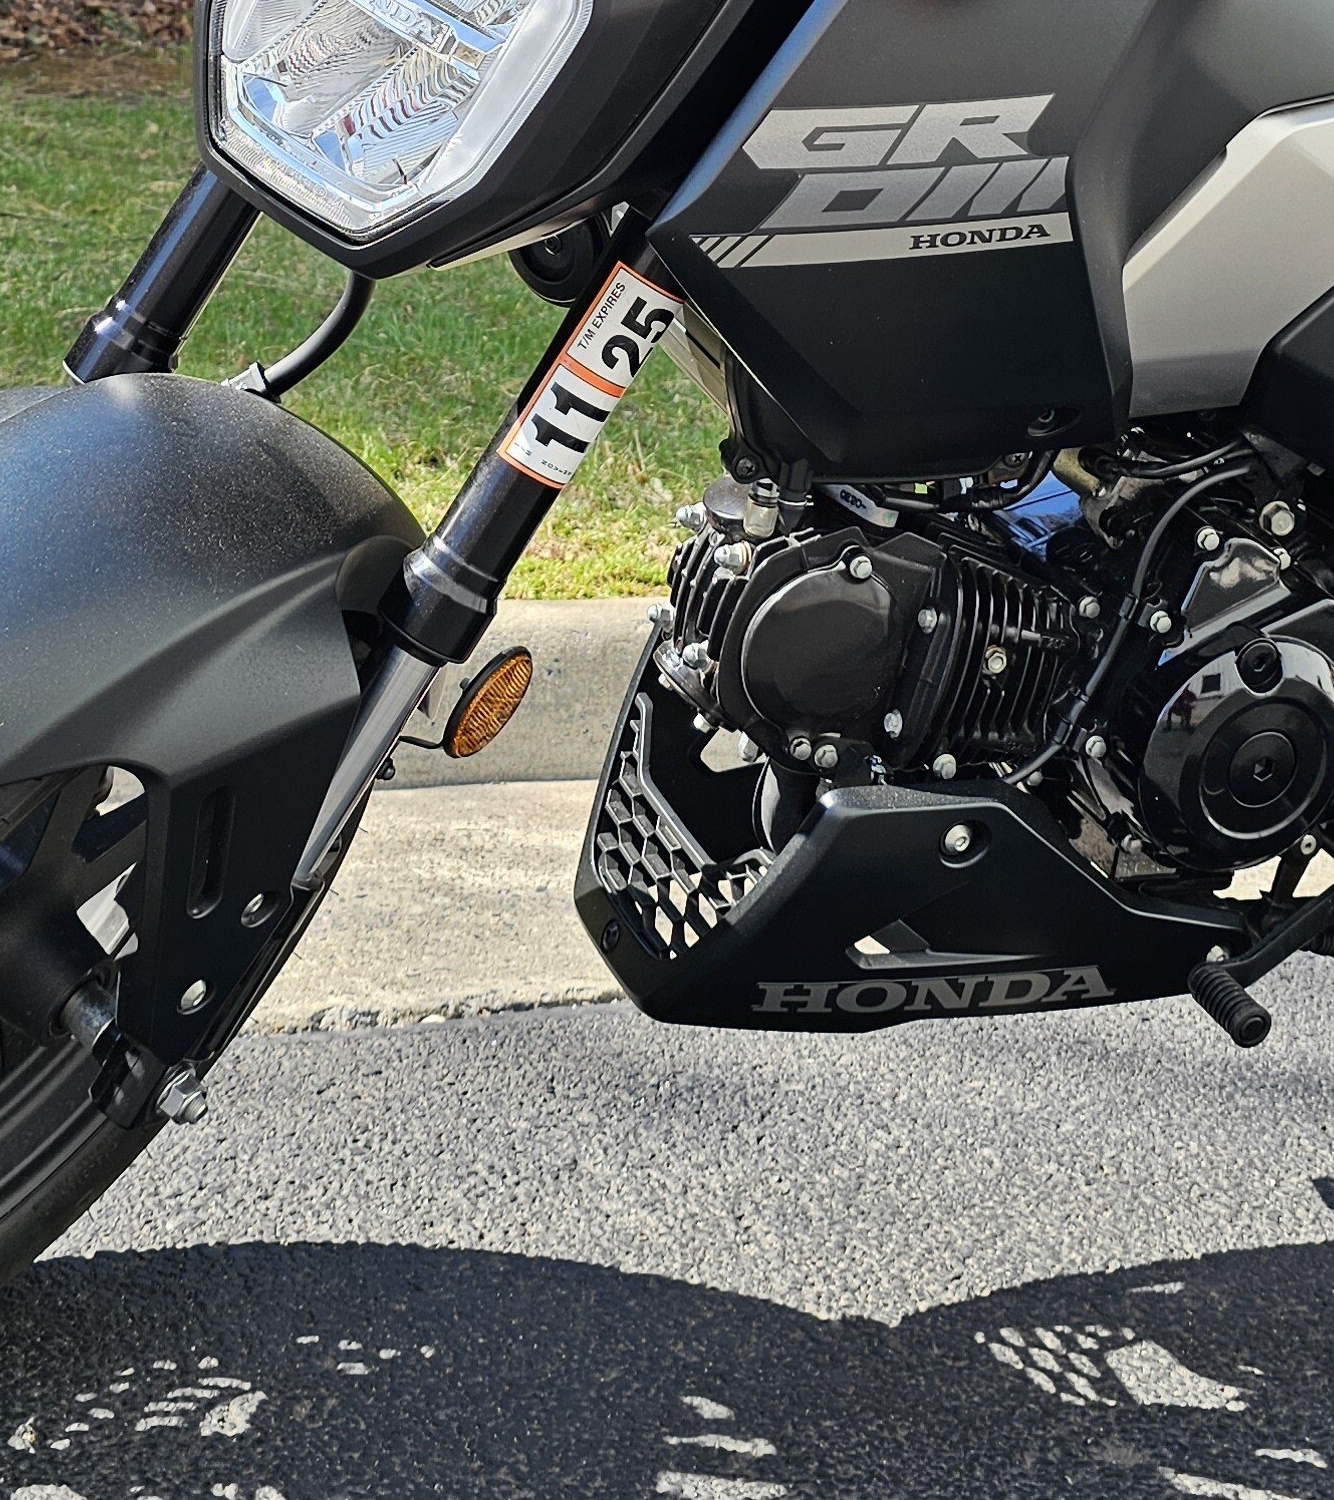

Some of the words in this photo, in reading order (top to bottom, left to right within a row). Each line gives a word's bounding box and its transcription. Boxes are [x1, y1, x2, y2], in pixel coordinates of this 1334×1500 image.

[909, 224, 1051, 250] HONDA
[577, 330, 596, 350] T/M
[592, 282, 625, 329] EXPIRES
[531, 382, 610, 453] 11
[601, 296, 675, 378] 25
[752, 965, 1116, 1013] HONDA
